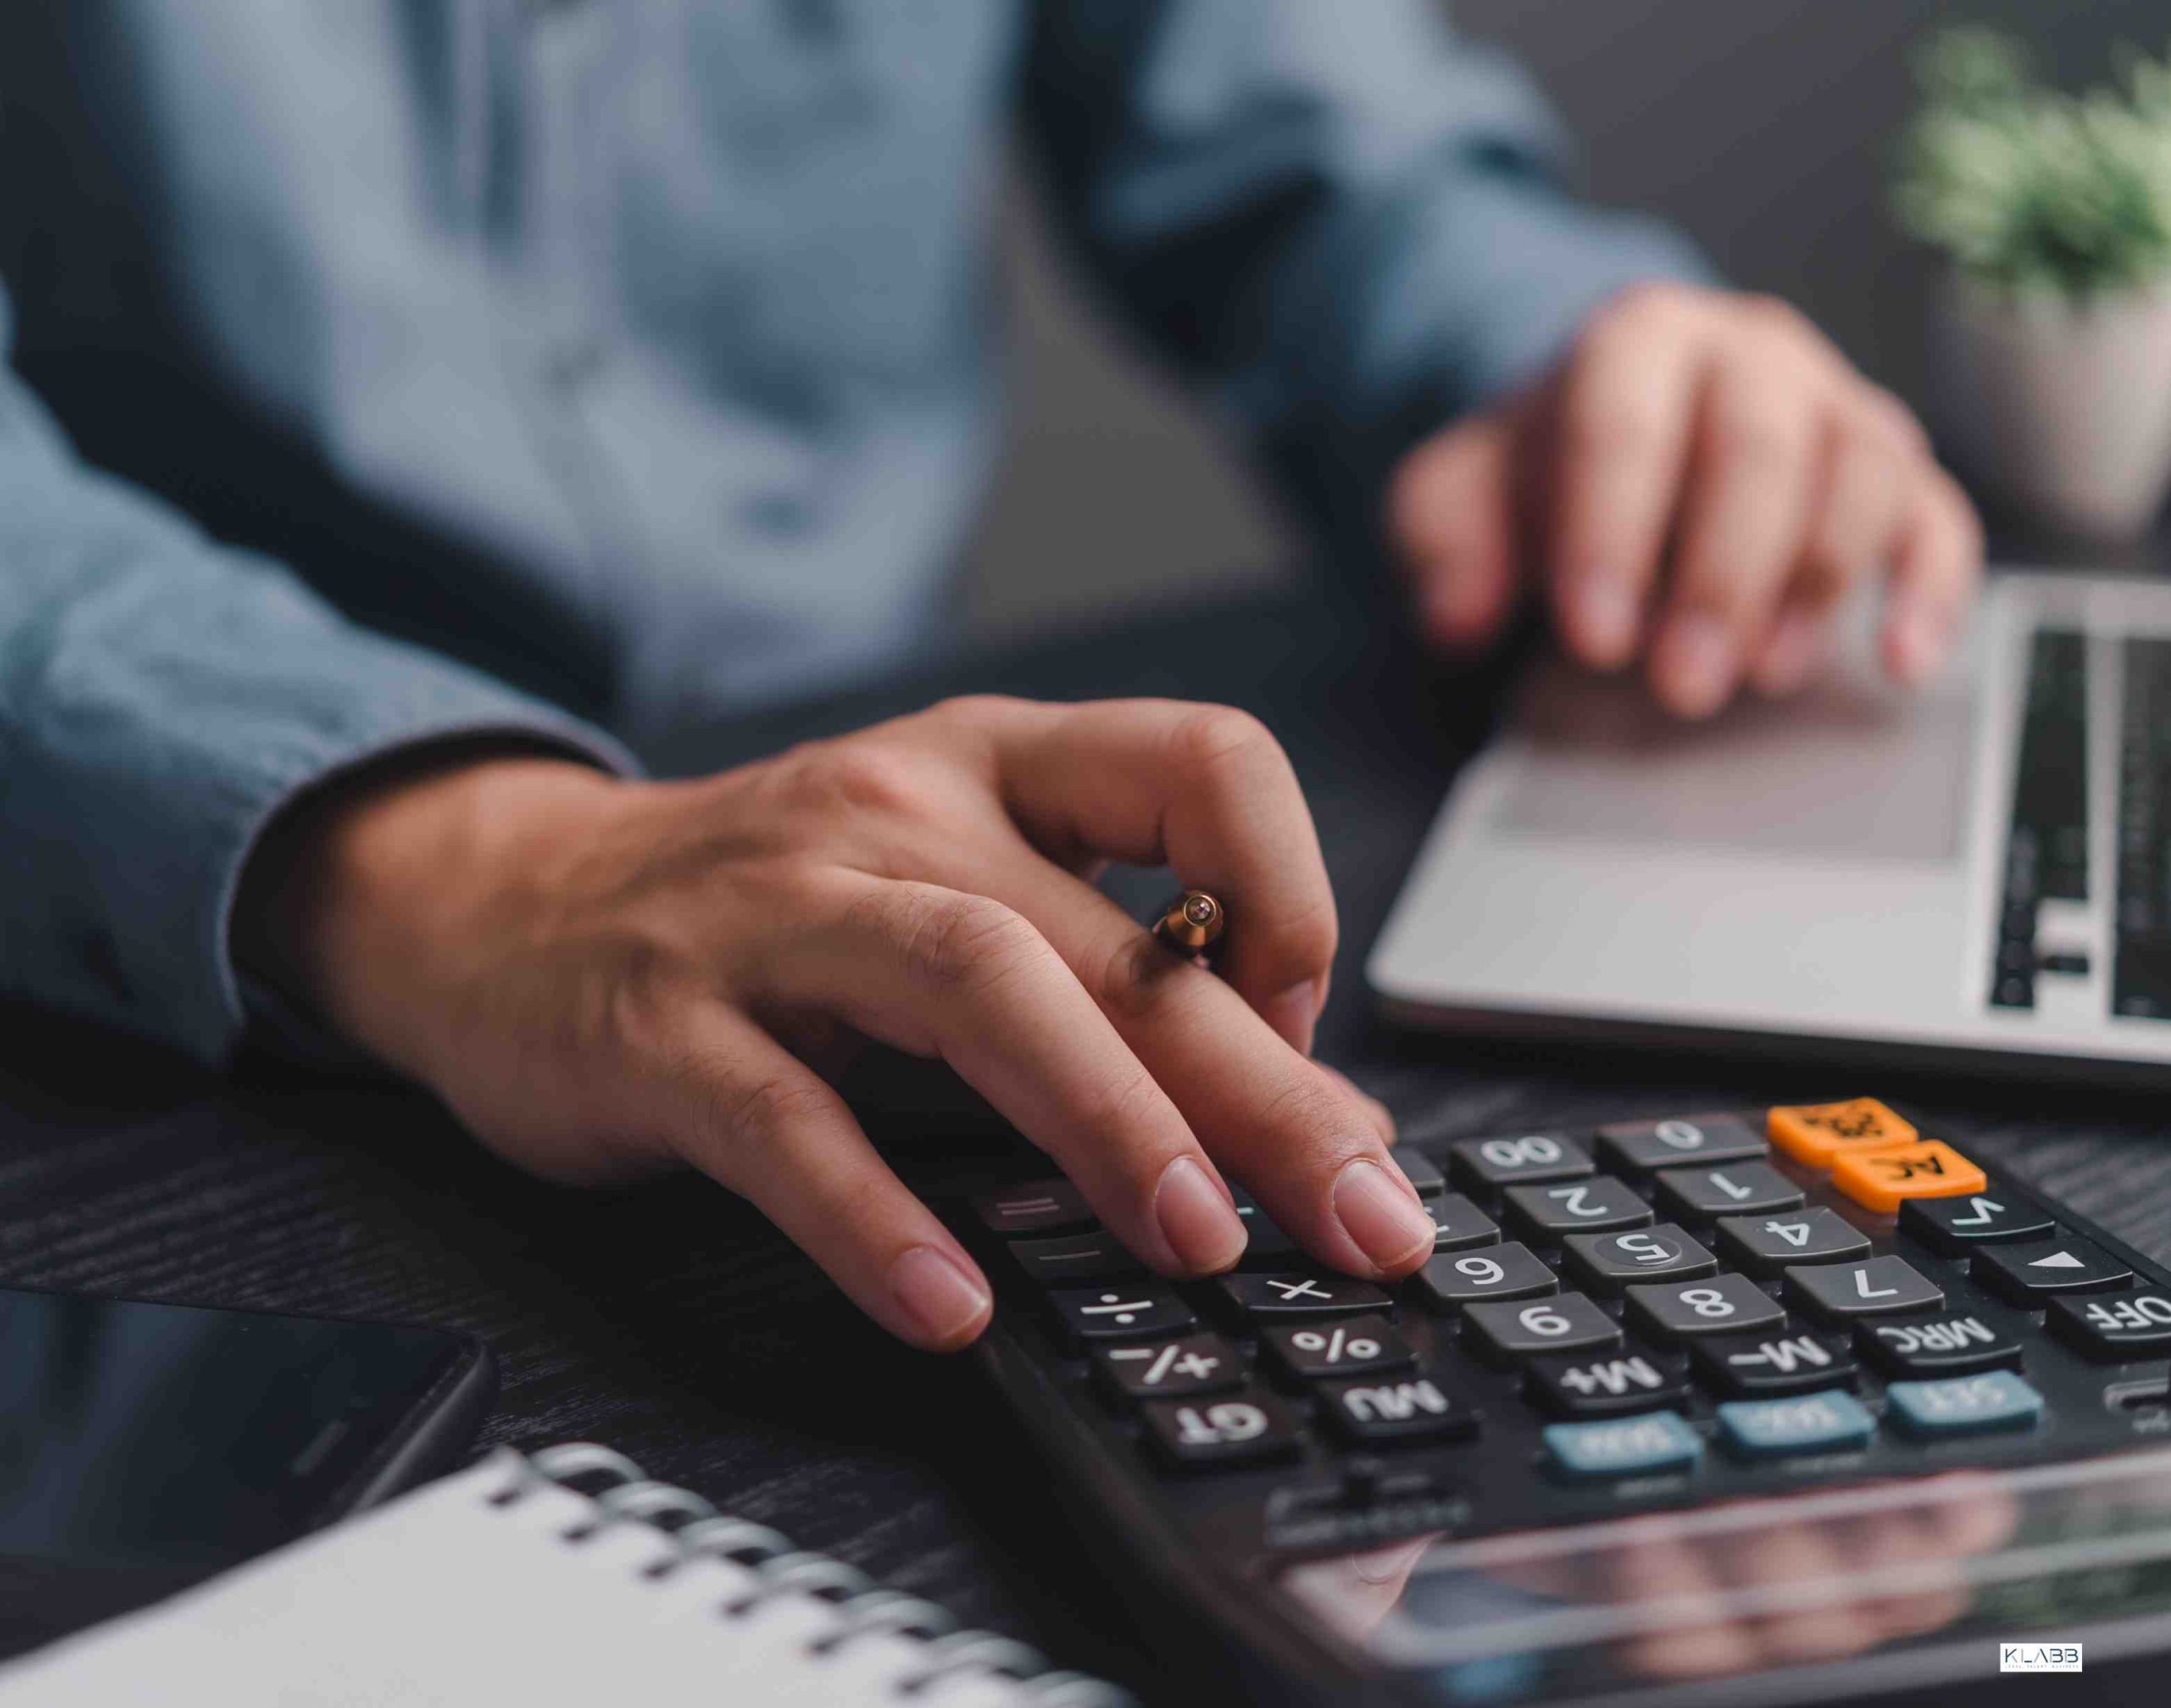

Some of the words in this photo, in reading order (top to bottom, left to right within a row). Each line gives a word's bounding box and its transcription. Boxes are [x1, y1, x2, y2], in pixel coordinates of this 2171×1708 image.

[1655, 1120, 1704, 1149] 0
[1481, 1136, 1561, 1167] 00
[1549, 1186, 1608, 1217] 2
[1710, 1173, 1751, 1199] 1
[1616, 1234, 1671, 1262] 5
[1765, 1221, 1811, 1246] 4
[1454, 1257, 1504, 1285] 6
[1854, 1270, 1898, 1298] 7
[1679, 1288, 1735, 1318] 8
[2086, 1296, 2171, 1330] OFF
[1519, 1306, 1571, 1337] 9
[1877, 1317, 1995, 1353] MRC
[1292, 1328, 1381, 1364] %
[1728, 1336, 1832, 1372] M-
[1560, 1357, 1664, 1394] M+
[1343, 1380, 1448, 1421] MU
[1176, 1403, 1268, 1443] GT
